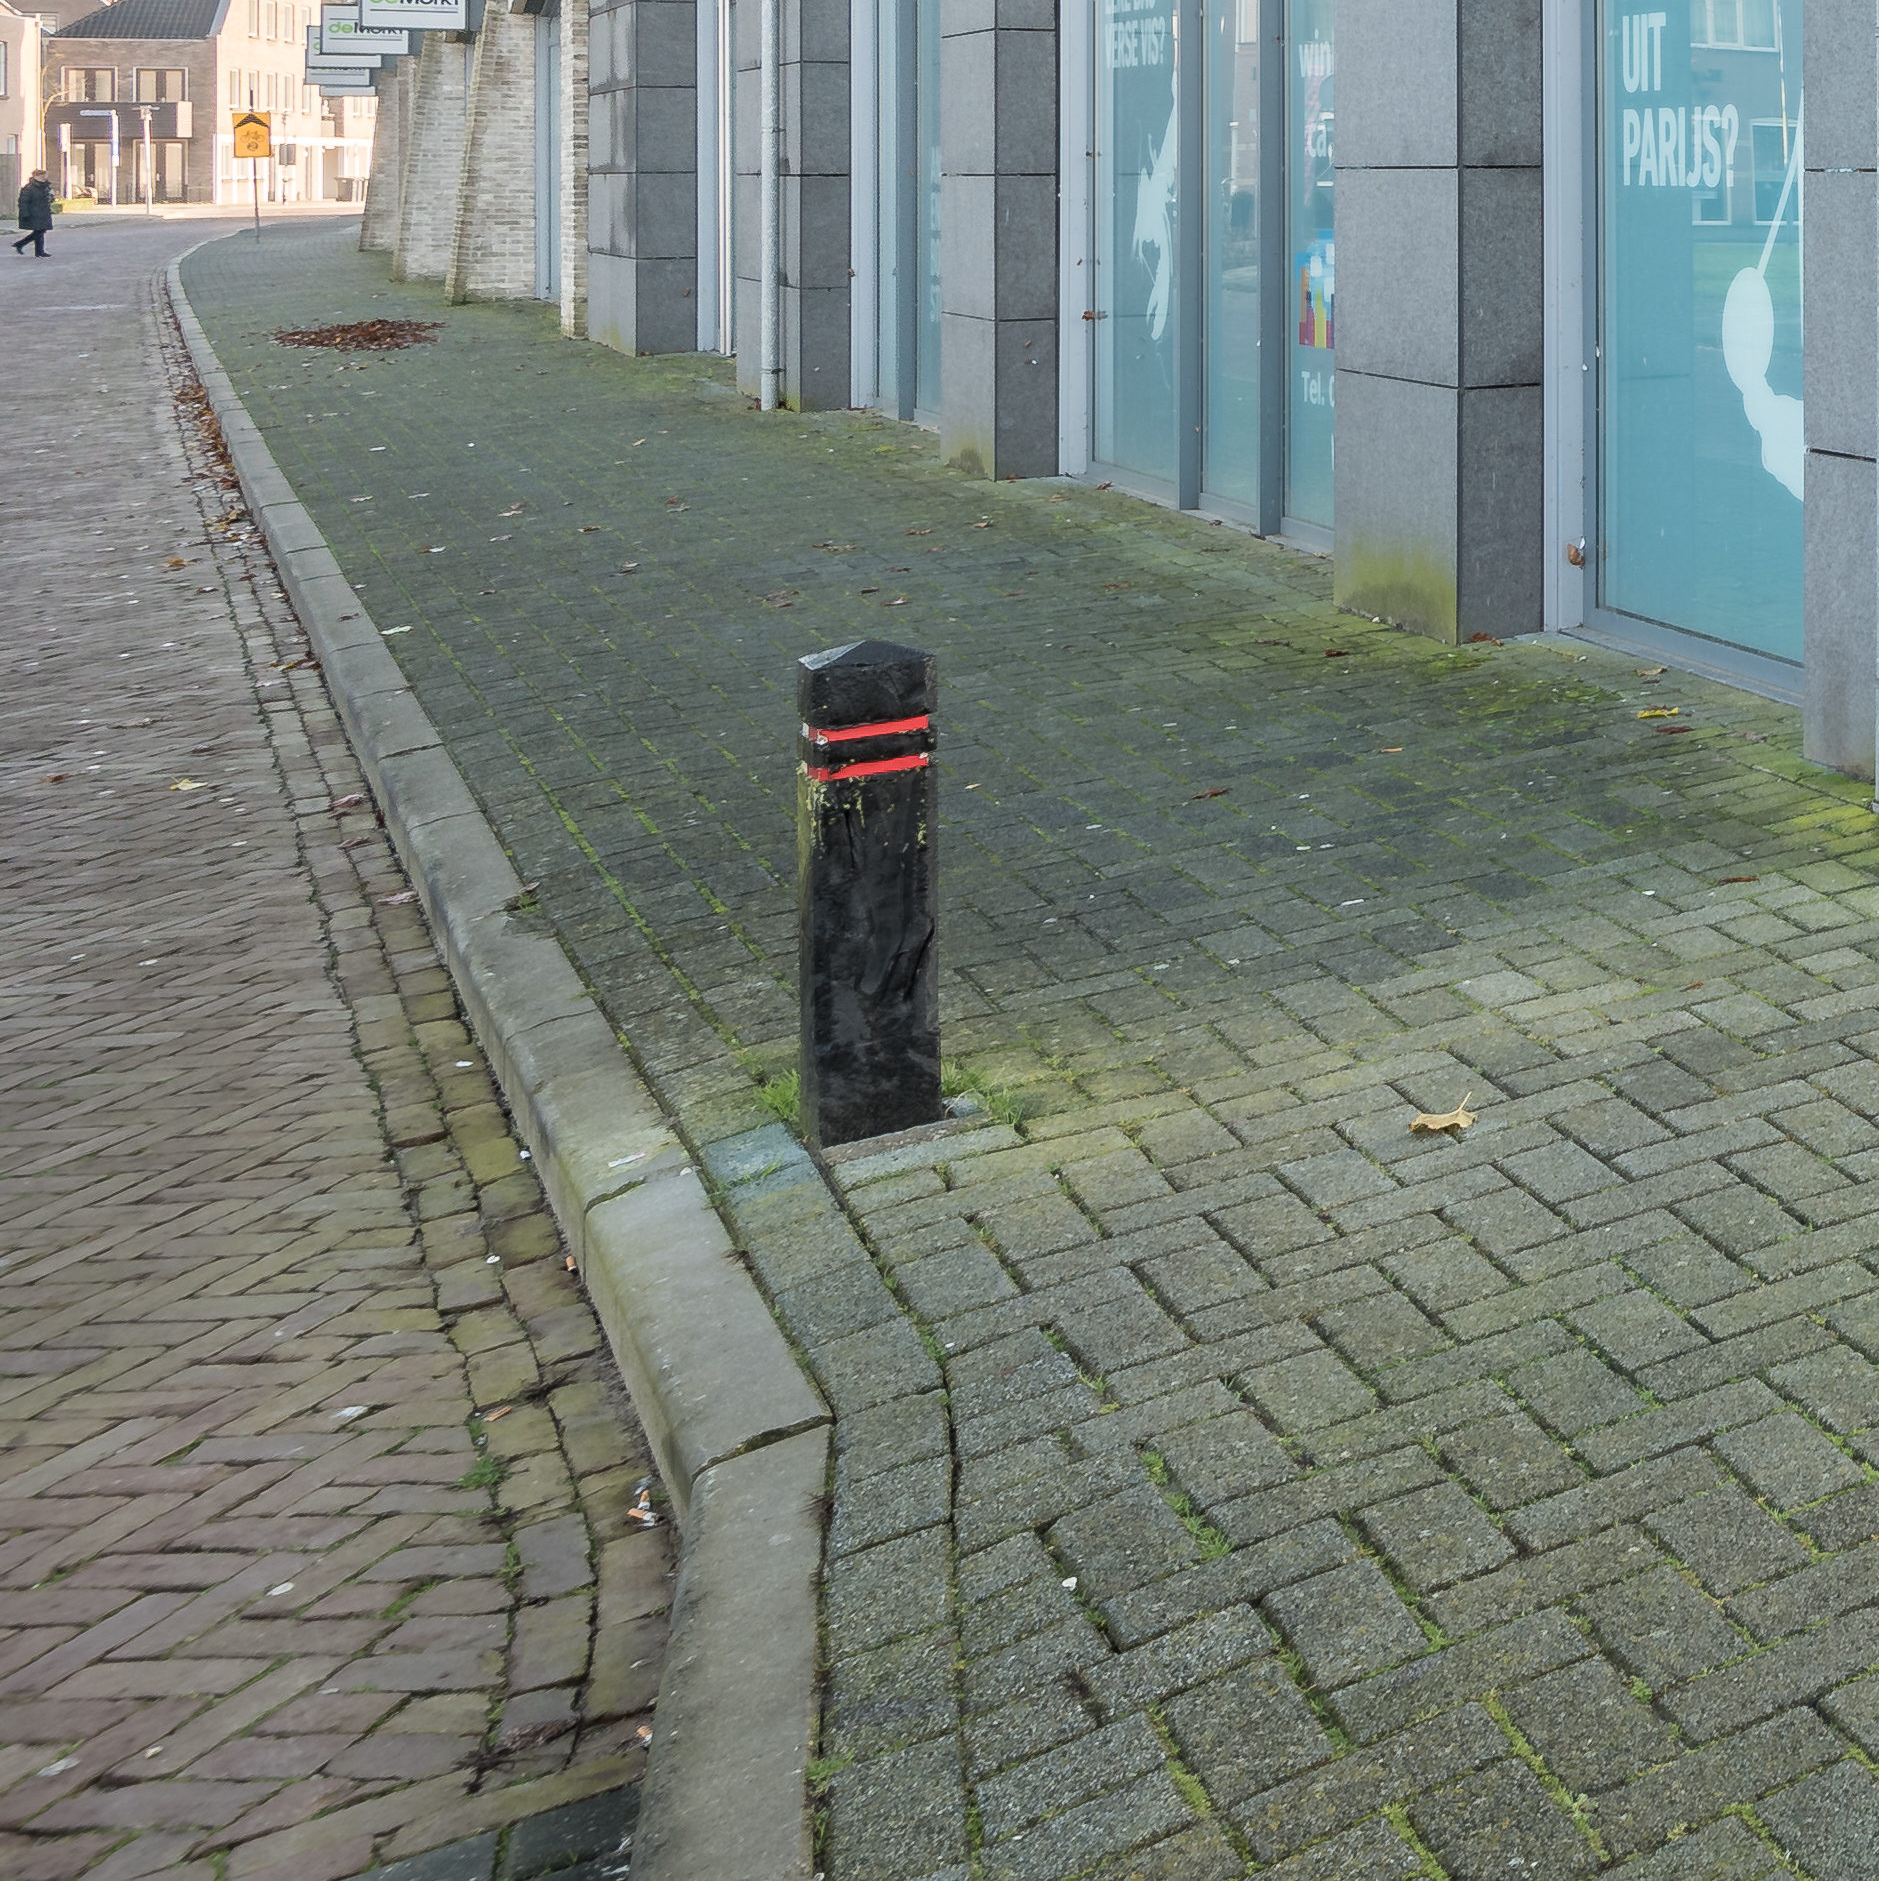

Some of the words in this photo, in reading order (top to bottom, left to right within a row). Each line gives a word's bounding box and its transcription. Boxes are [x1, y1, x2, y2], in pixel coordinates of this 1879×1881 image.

[1105, 20, 1139, 70] VERSE
[1140, 16, 1166, 66] VIS?
[1622, 12, 1667, 93] UIT
[1622, 104, 1740, 188] PARIJS?
[1301, 370, 1325, 406] Tel.
